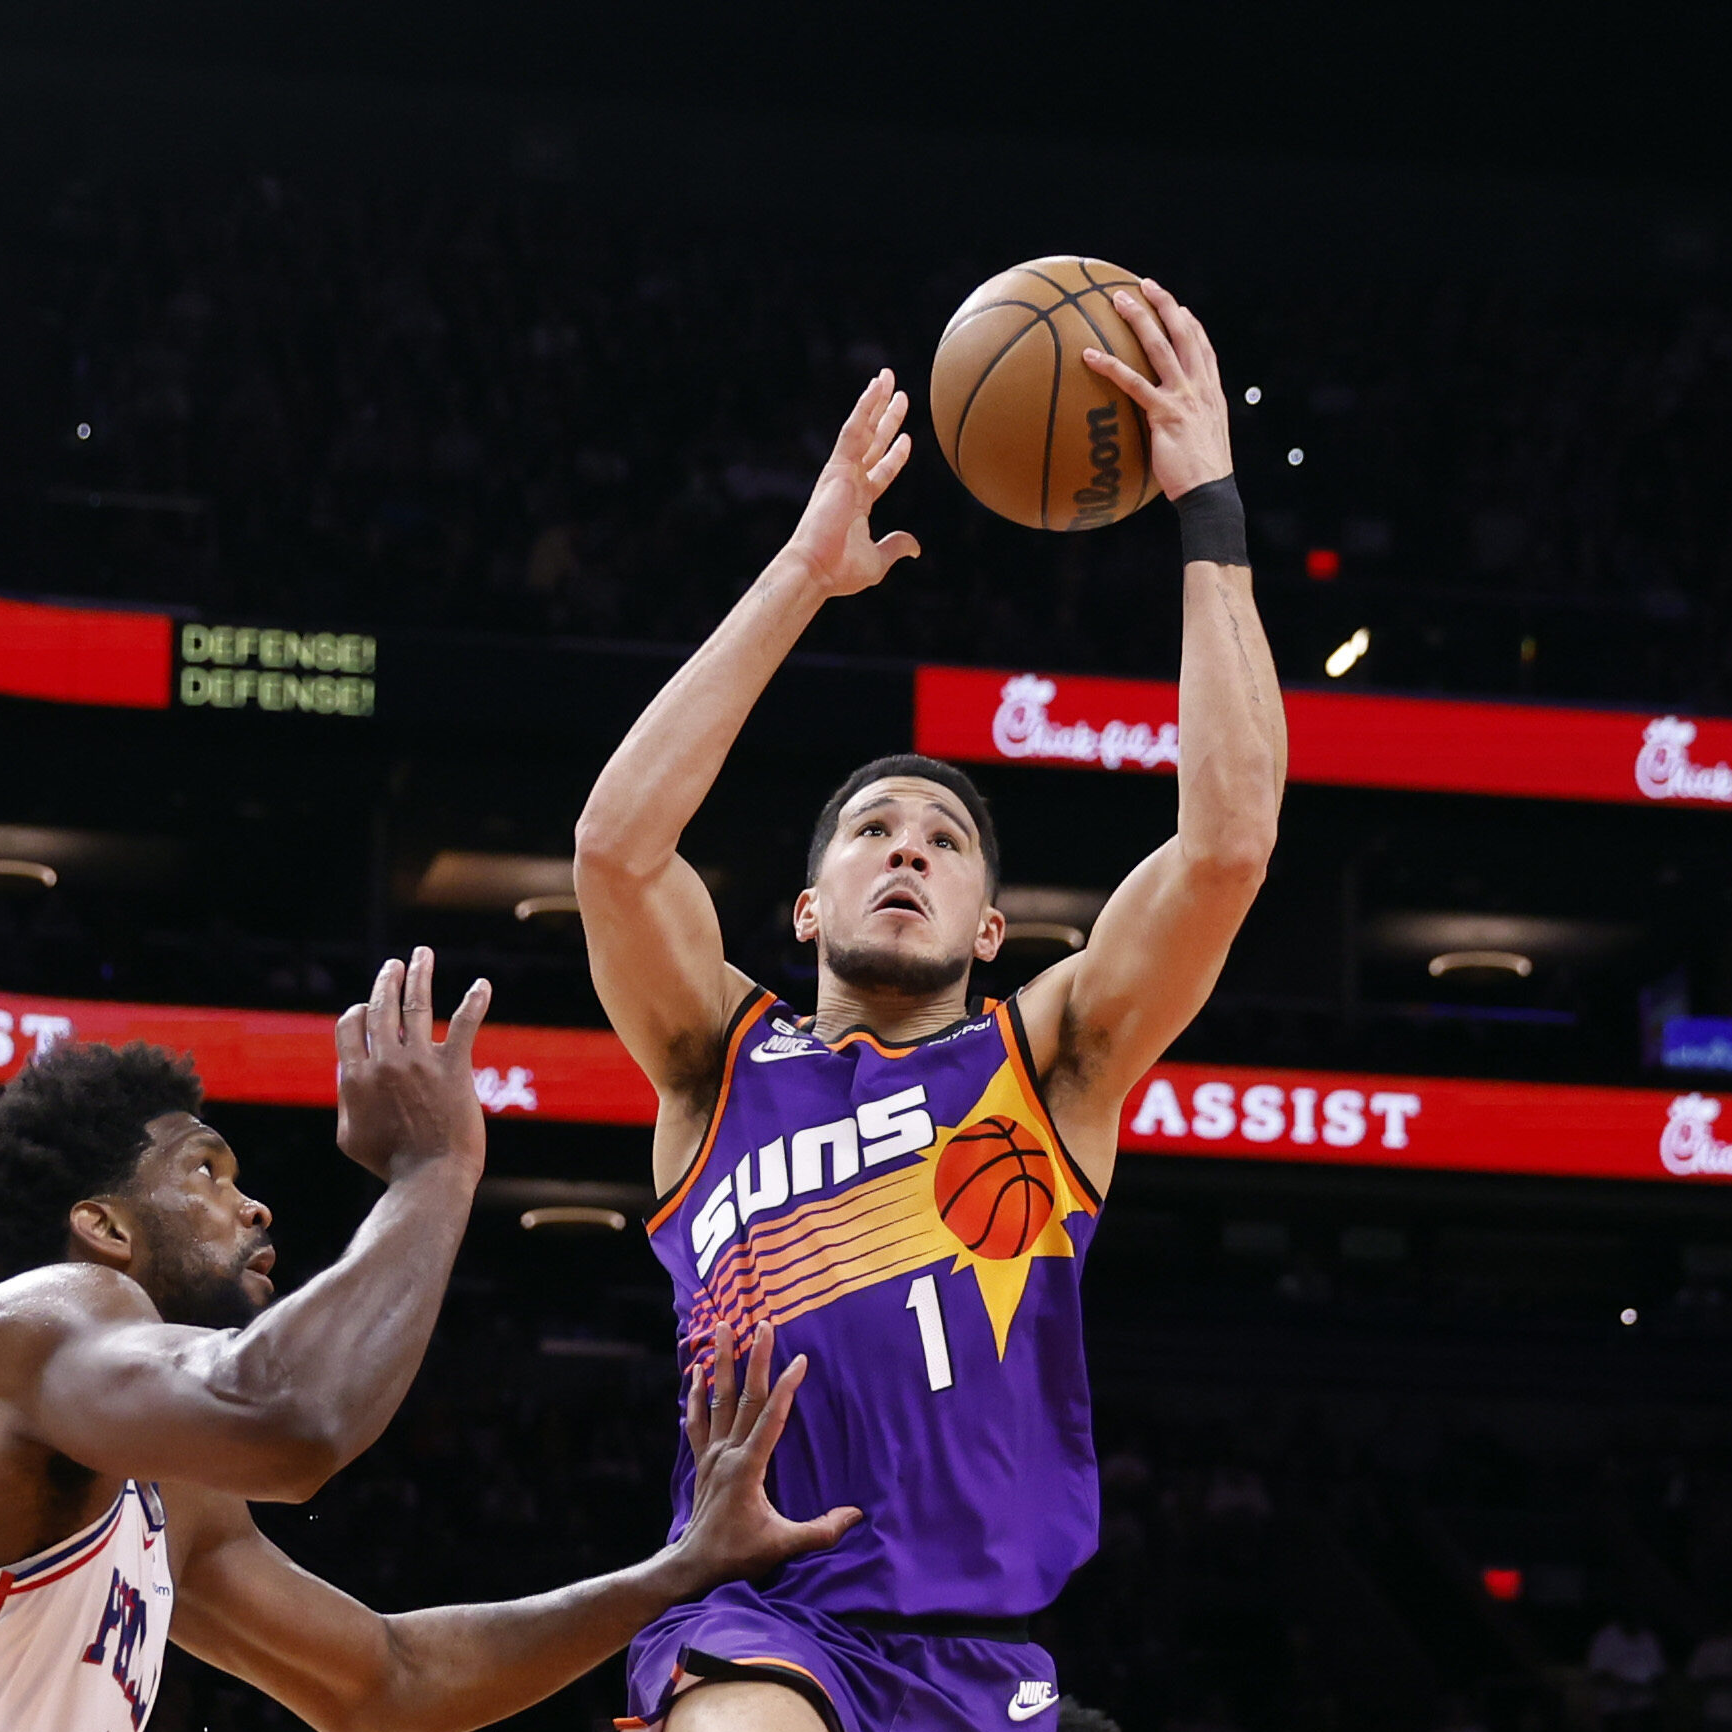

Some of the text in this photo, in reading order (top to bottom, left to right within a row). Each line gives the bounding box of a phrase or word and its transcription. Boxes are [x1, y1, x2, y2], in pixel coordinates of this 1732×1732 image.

[181, 623, 377, 674] DEFENSE!
[180, 667, 376, 717] DEFENSE!
[1132, 1078, 1421, 1150] ASSIST
[905, 1274, 953, 1392] 1
[1017, 1680, 1052, 1704] NIKE
